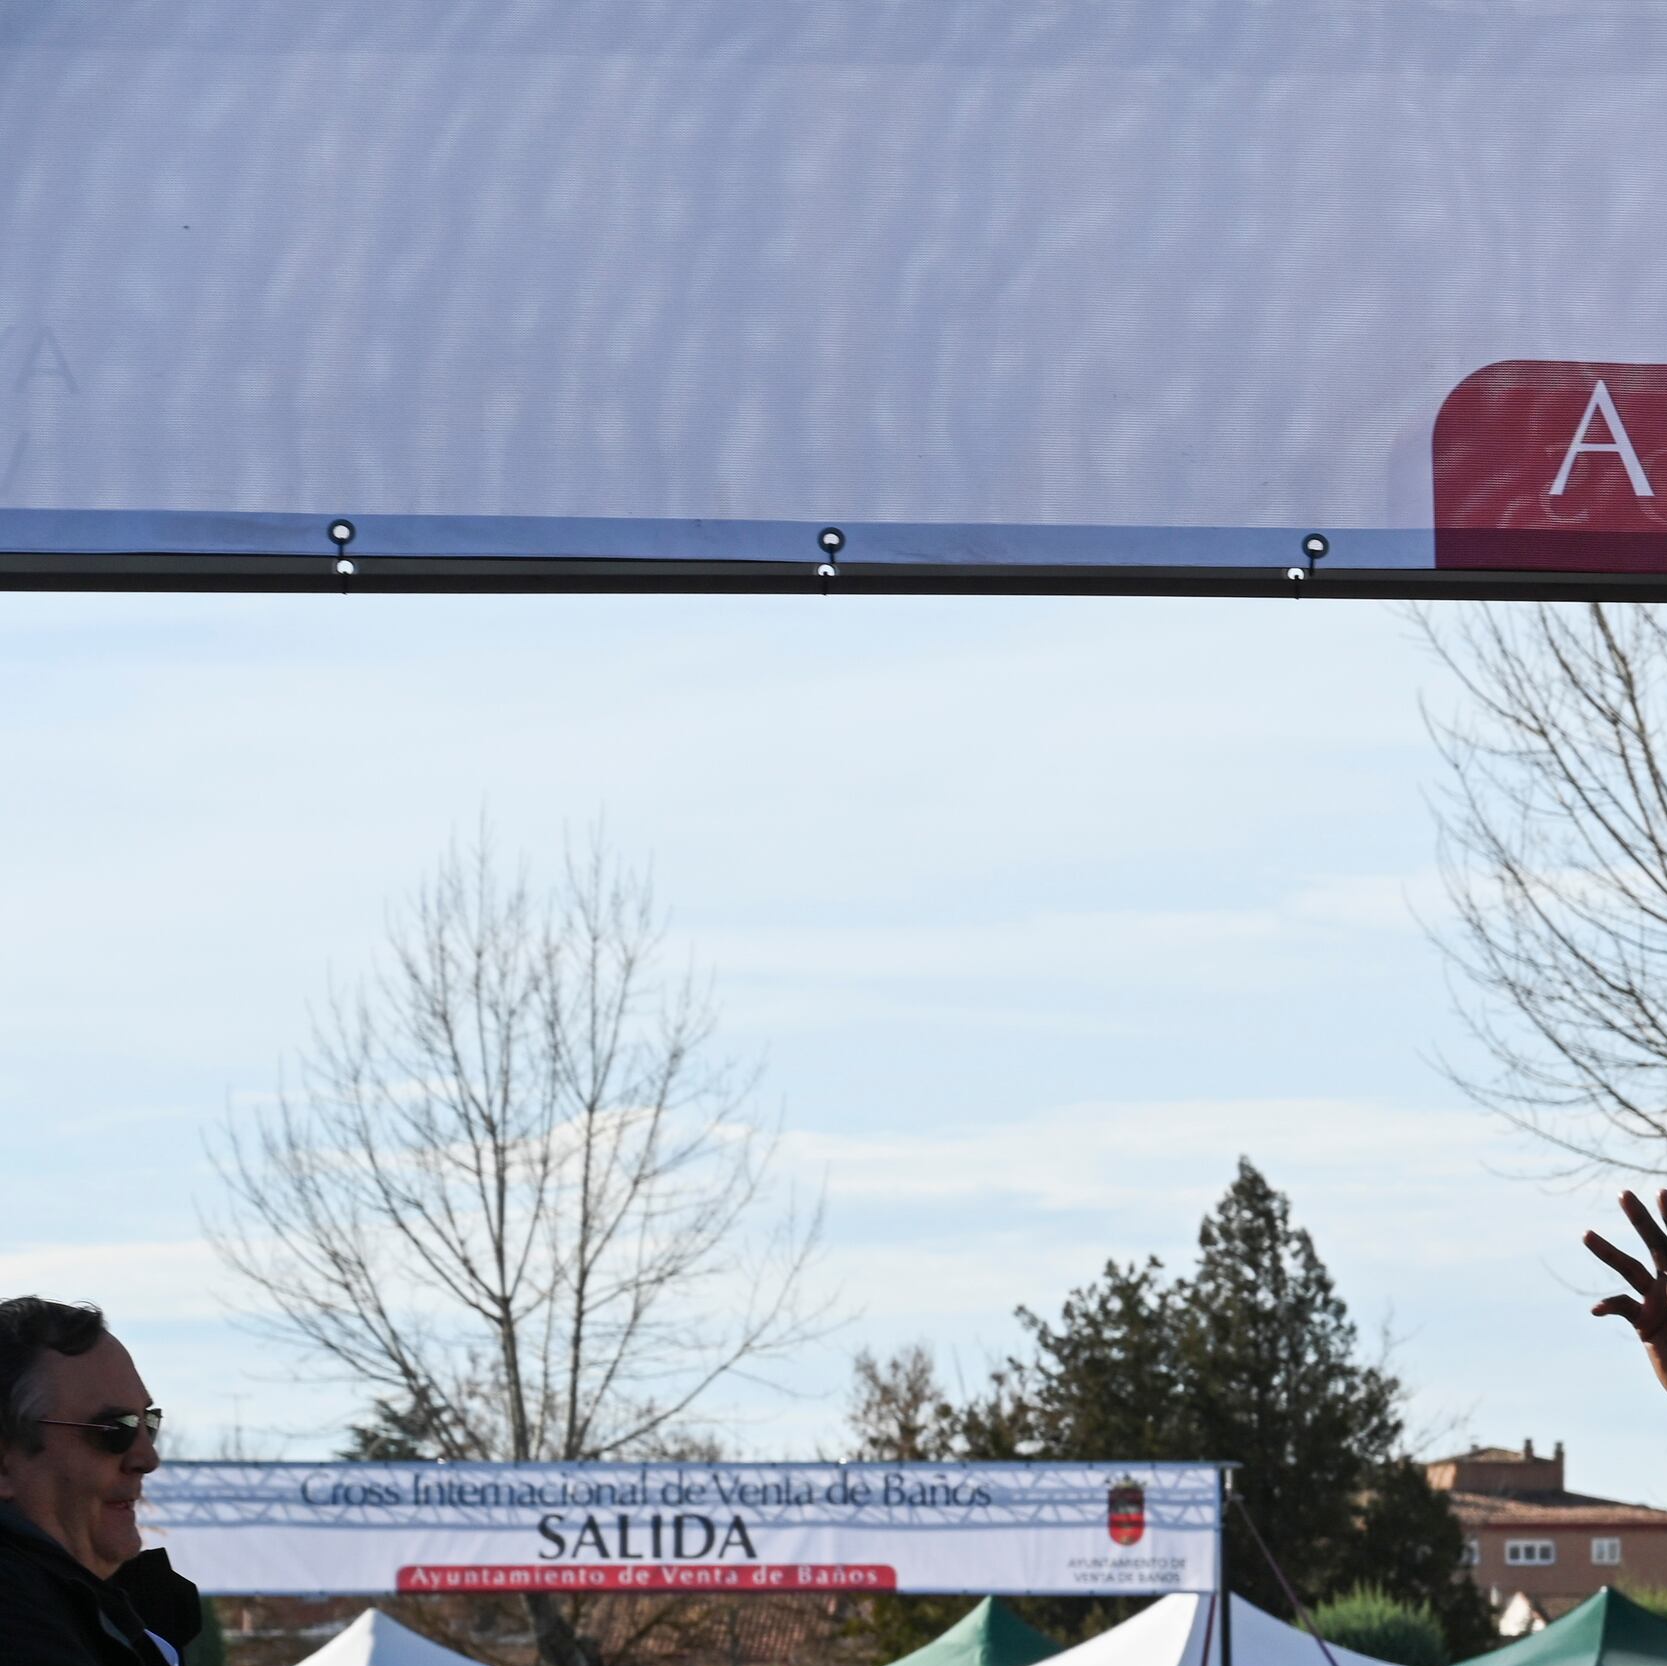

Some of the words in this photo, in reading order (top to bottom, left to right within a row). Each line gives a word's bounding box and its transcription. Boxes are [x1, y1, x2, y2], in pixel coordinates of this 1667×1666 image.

[301, 1472, 400, 1507] Cross
[413, 1470, 648, 1507] Internacional
[661, 1468, 706, 1507] de
[711, 1473, 813, 1507] Venta
[825, 1468, 871, 1507] de
[882, 1472, 992, 1508] Baños
[537, 1513, 757, 1560] SALIDA
[410, 1564, 606, 1588] Ayuntamiento
[618, 1564, 650, 1585] de
[662, 1565, 738, 1585] Venta
[752, 1564, 783, 1585] de
[798, 1564, 878, 1585] Baños
